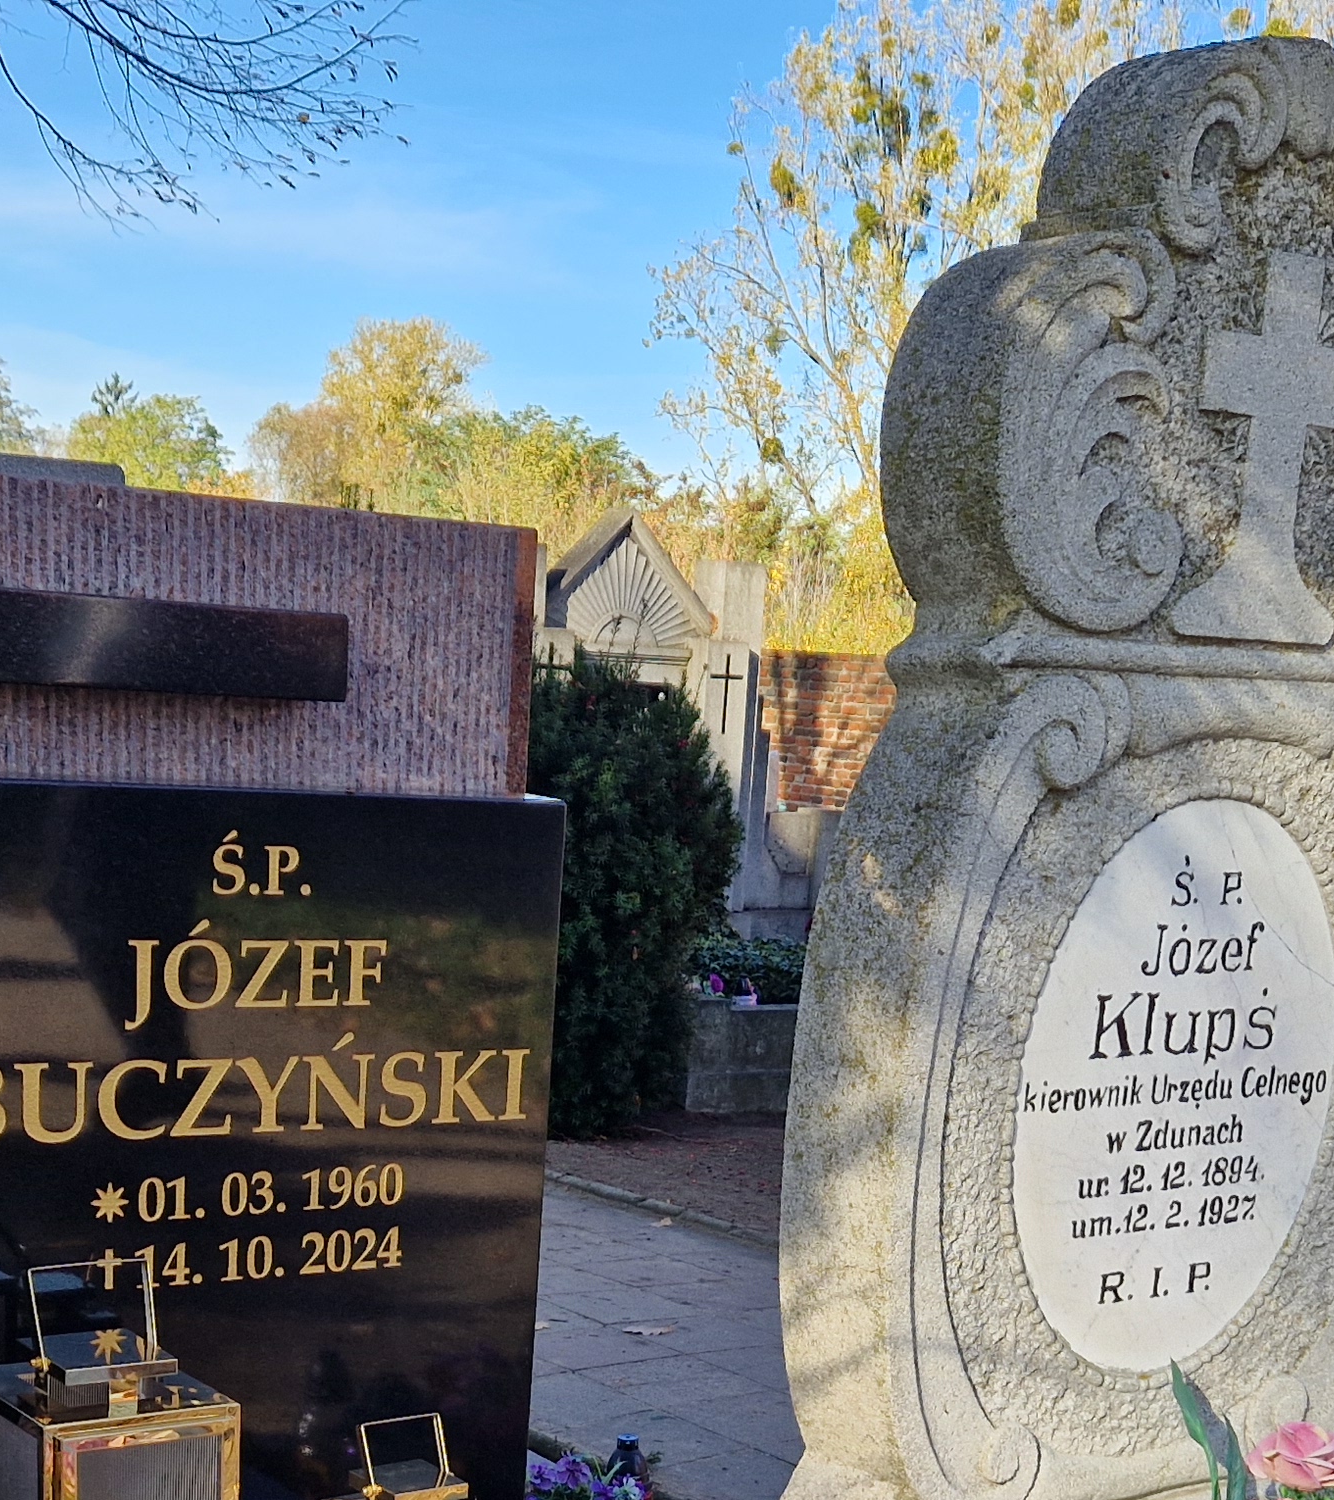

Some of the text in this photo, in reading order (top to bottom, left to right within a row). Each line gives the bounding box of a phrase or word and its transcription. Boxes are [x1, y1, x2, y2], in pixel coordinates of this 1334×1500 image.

[211, 829, 312, 896] Ś.P.
[124, 918, 388, 1032] JÓZEF
[1141, 920, 1265, 977] Józef
[1087, 986, 1278, 1065] Klupś
[1023, 1064, 1327, 1114] kierownik Urzędu Celnego
[1106, 1113, 1244, 1154] w Zdunach
[138, 1162, 404, 1222] 01. 03. 1960
[1119, 1164, 1153, 1195] 12.
[1160, 1160, 1193, 1191] 12.
[1164, 1199, 1190, 1230] 2.
[134, 1225, 403, 1289] 14. 10. 2024
